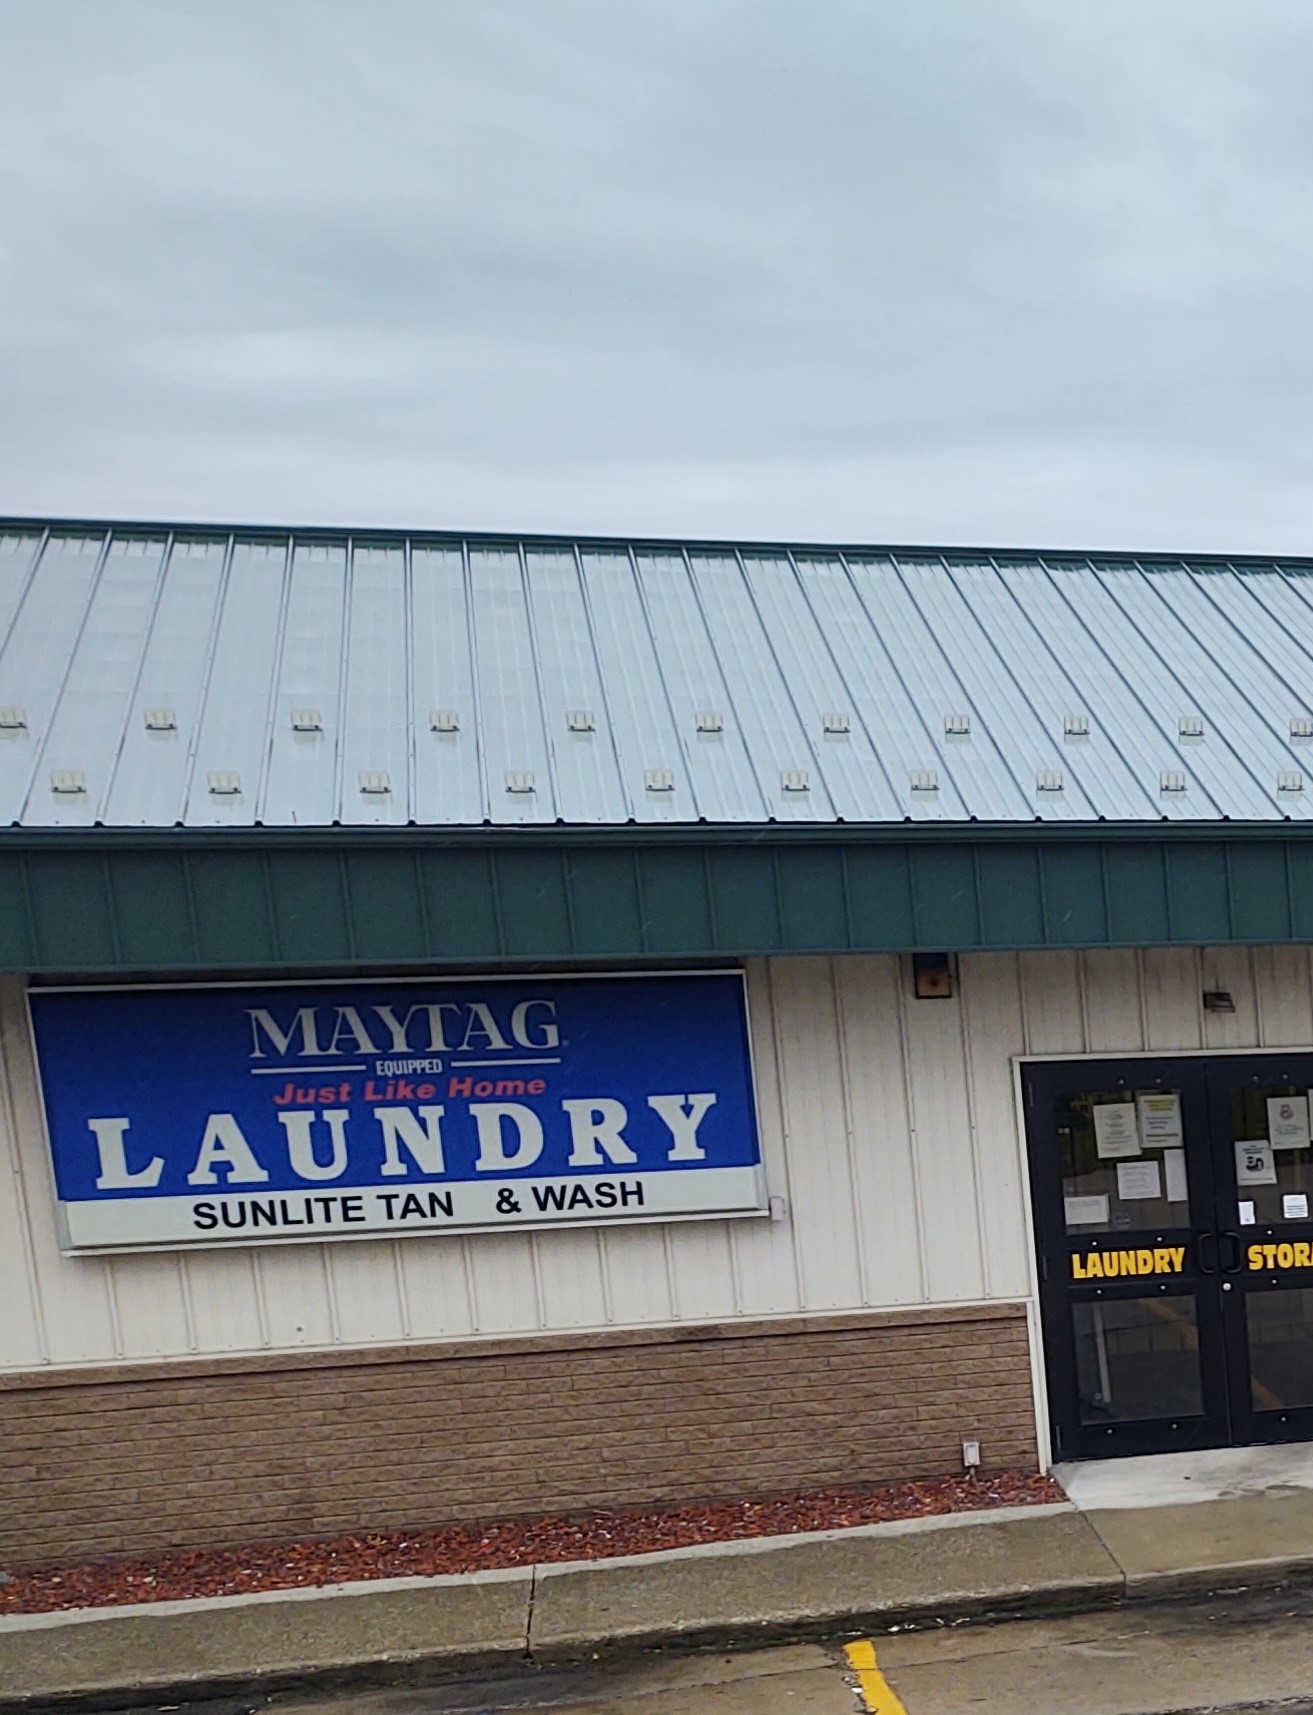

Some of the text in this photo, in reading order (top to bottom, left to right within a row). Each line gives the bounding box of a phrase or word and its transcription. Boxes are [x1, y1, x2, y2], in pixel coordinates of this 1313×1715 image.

[246, 1000, 560, 1058] MAYTAG
[375, 1058, 443, 1077] EQUIPPED
[274, 1076, 547, 1105] Just Like Home
[88, 1092, 718, 1190] LAUNDRY
[192, 1181, 645, 1230] SUNLITE TAN & WASH
[1071, 1246, 1186, 1279] LAUNDRY
